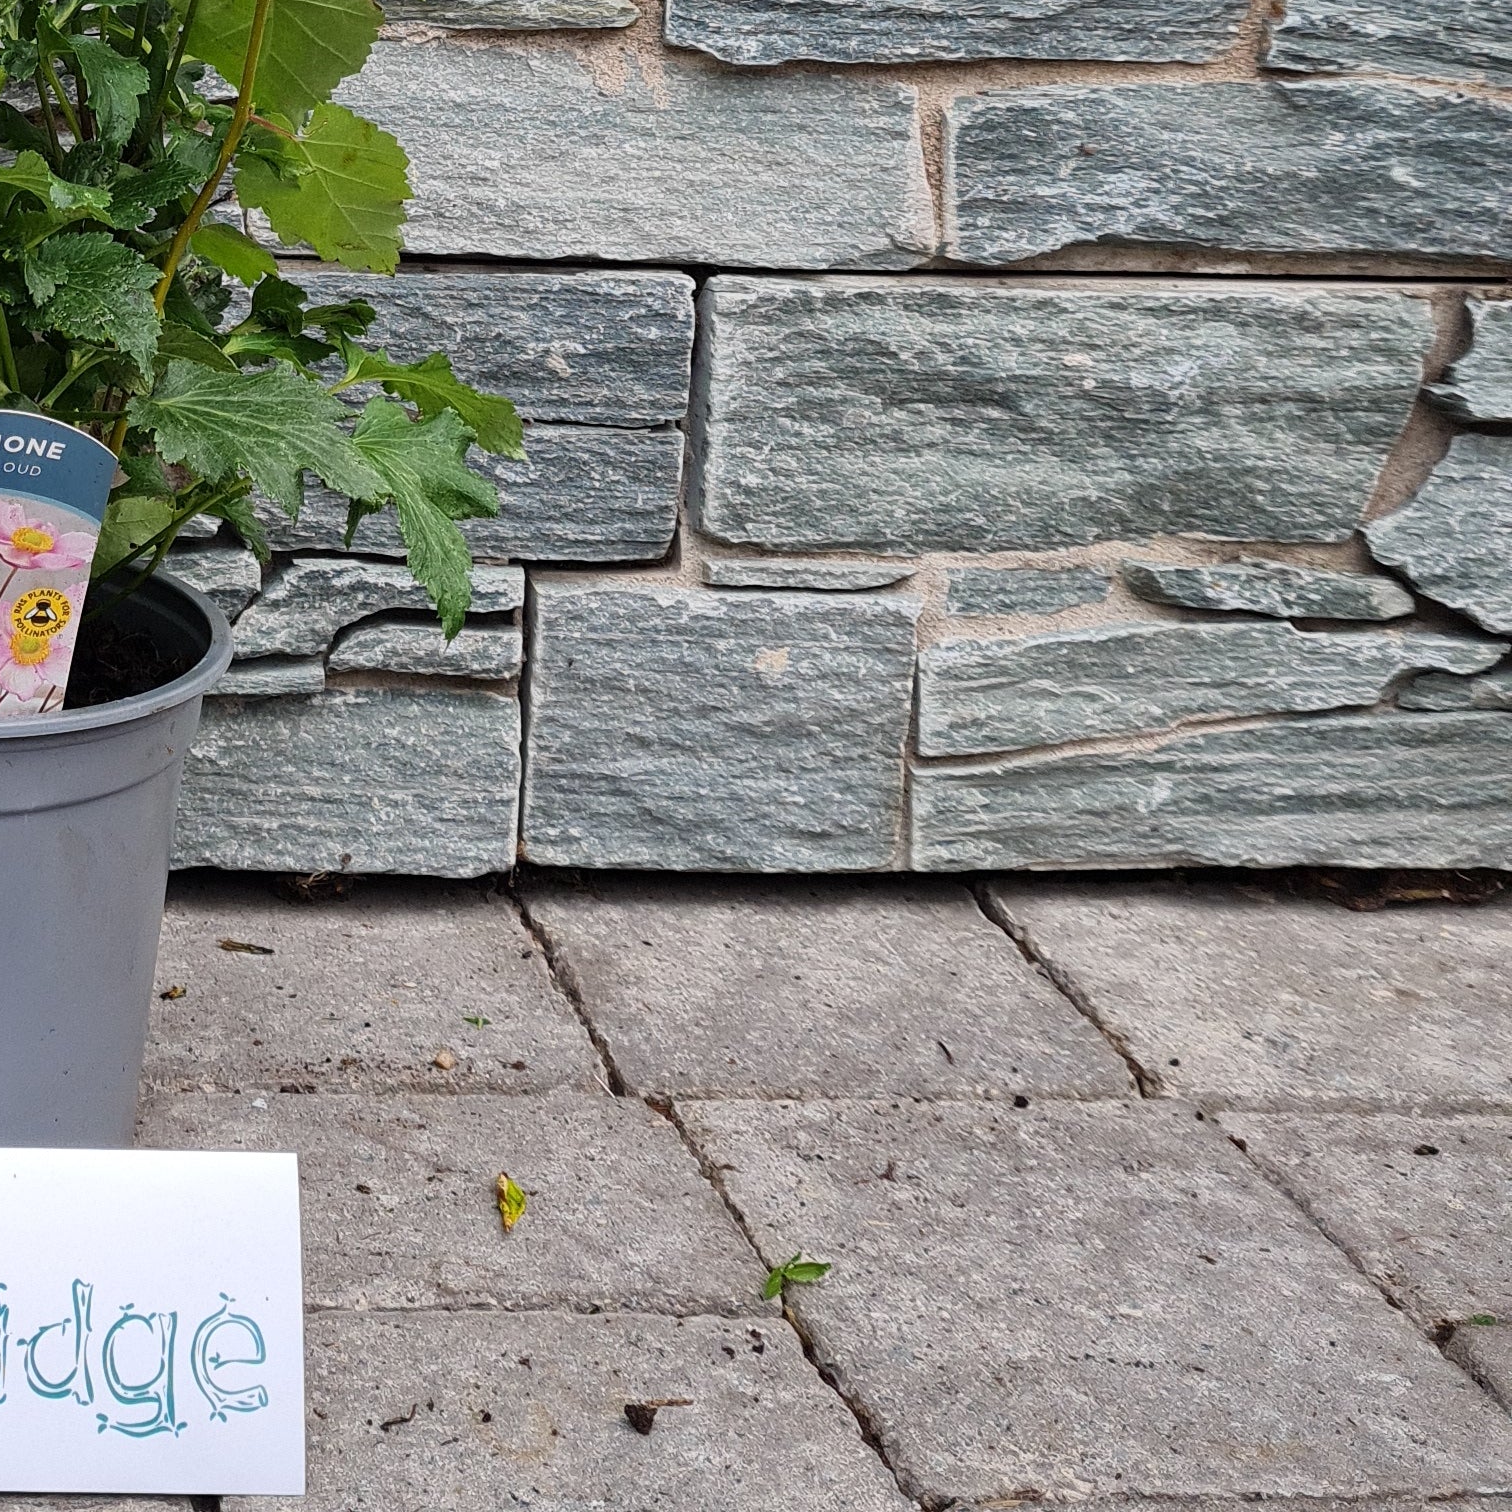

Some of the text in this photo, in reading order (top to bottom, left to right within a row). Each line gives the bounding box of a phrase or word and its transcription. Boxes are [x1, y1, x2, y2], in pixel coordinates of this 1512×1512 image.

[14, 589, 71, 616] RHS PLANTS FOR
[14, 618, 67, 638] POLLINATORS
